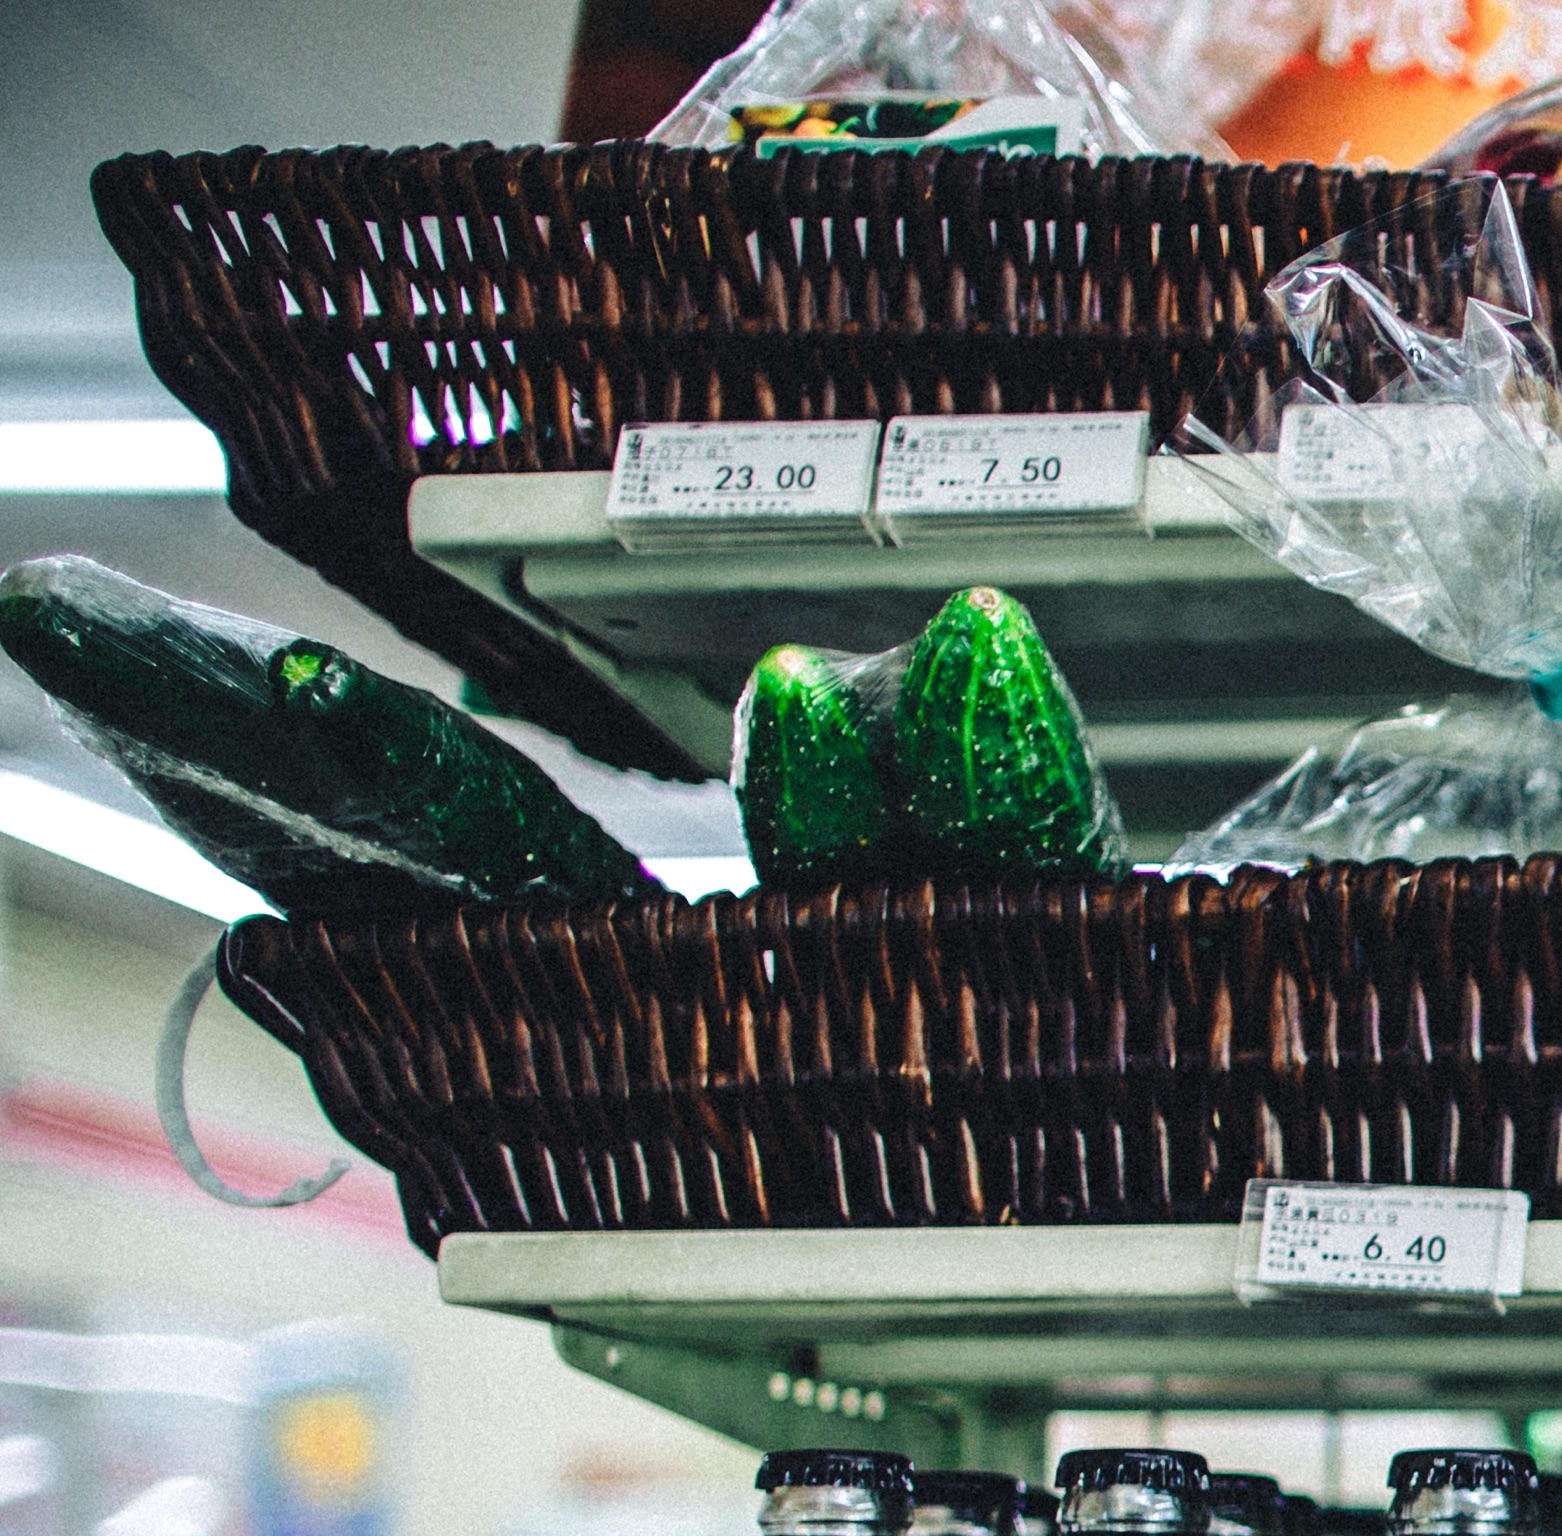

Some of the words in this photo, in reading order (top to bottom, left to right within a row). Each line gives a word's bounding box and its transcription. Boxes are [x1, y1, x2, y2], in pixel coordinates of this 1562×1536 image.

[714, 464, 817, 491] 23.00
[980, 456, 1062, 484] 7.50
[1363, 1233, 1447, 1263] 6.40
